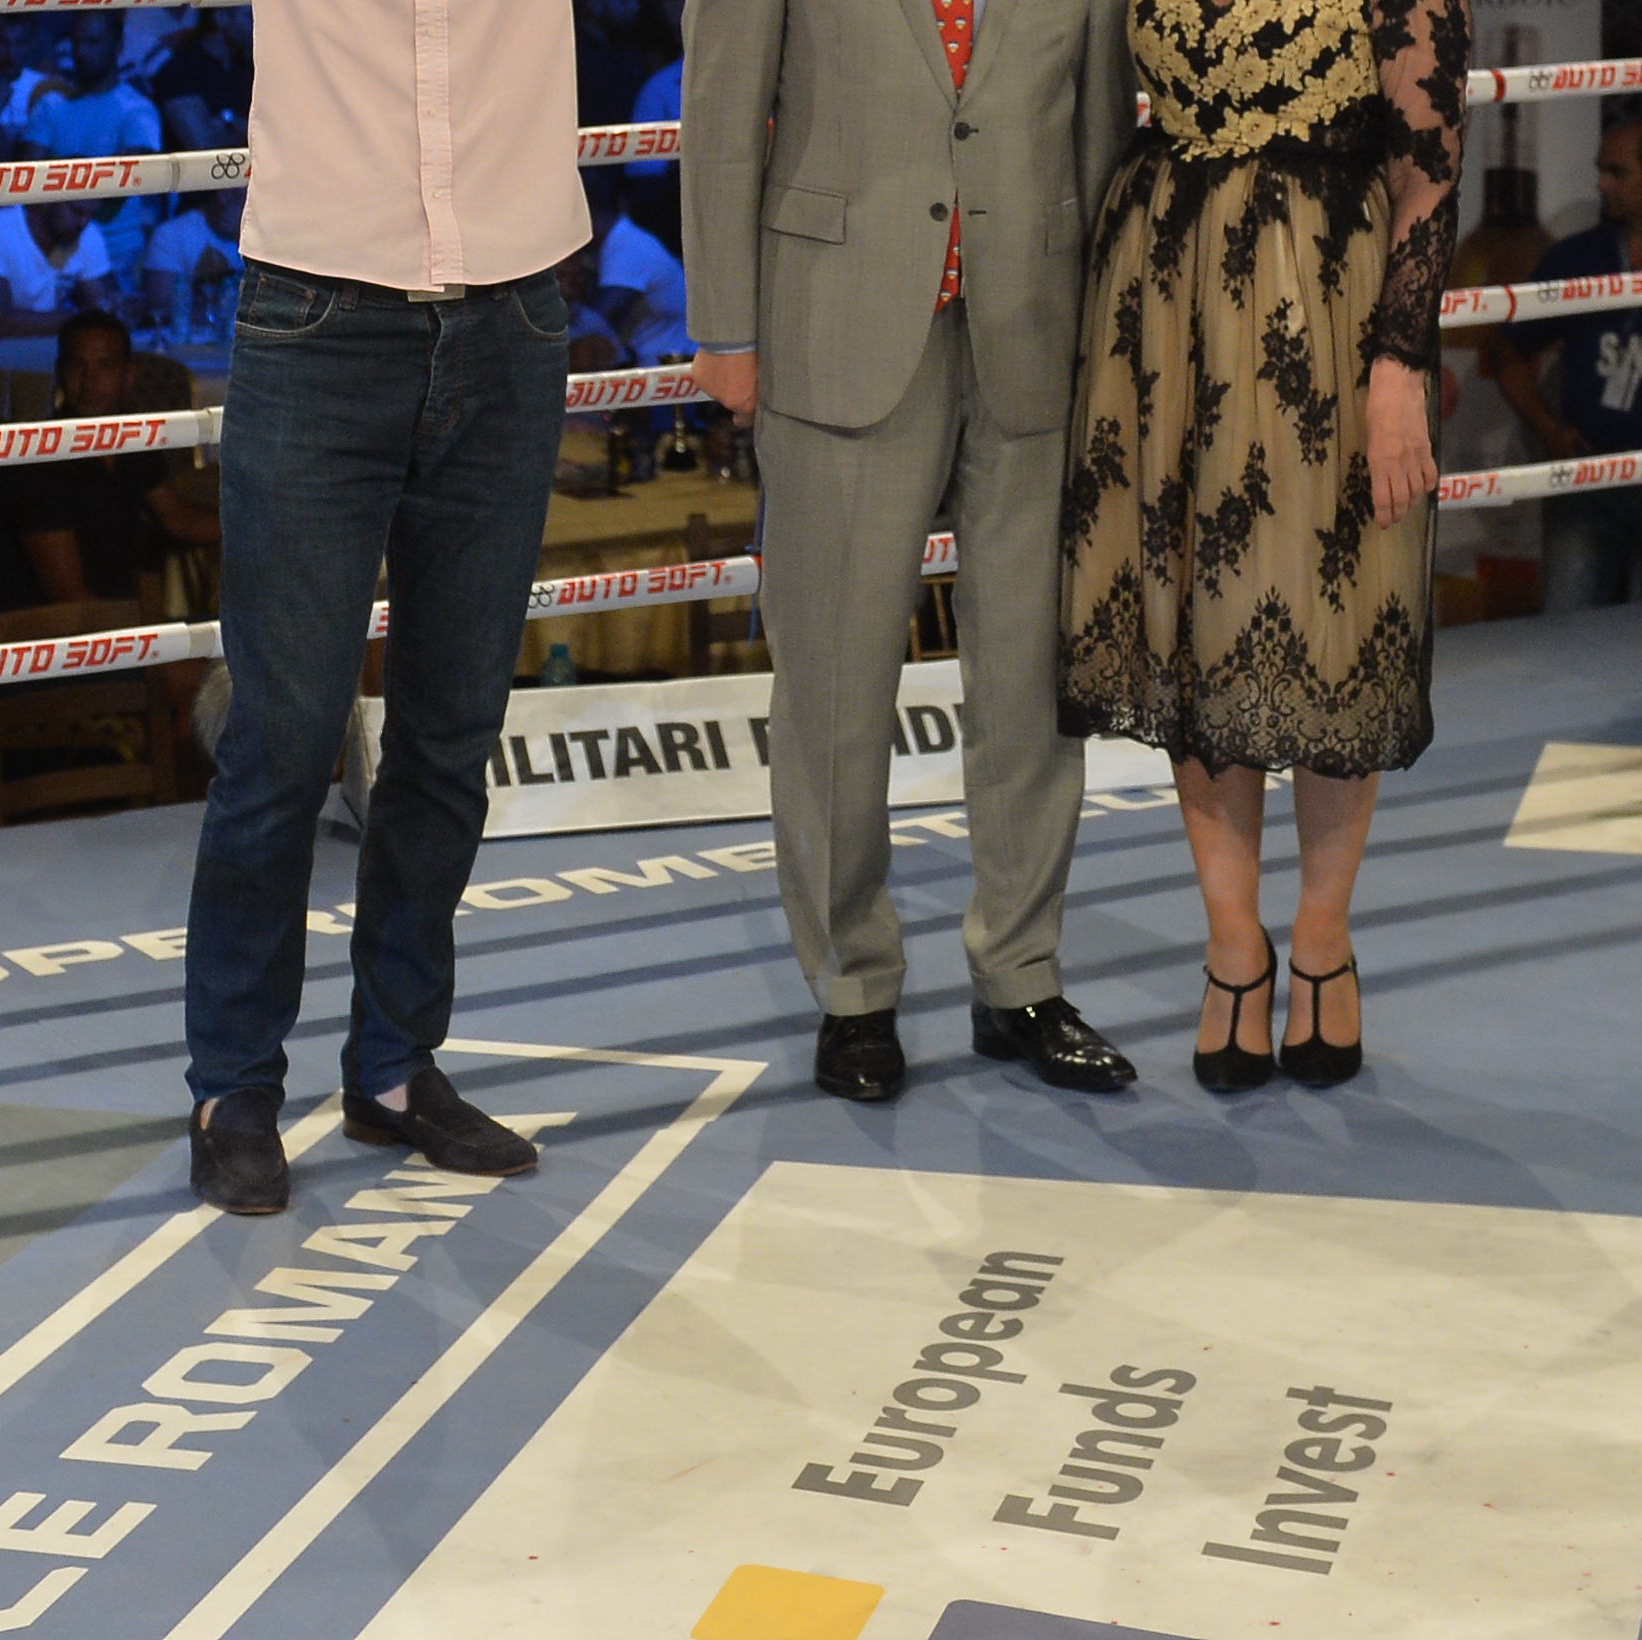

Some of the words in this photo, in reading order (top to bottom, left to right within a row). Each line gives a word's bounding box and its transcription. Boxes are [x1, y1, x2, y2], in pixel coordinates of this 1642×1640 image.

[1552, 64, 1617, 91] AUTO
[636, 127, 680, 155] SO
[43, 160, 141, 192] SOFT
[1562, 275, 1625, 300] AUTO
[566, 376, 648, 408] AUTO
[656, 369, 702, 400] SO
[71, 419, 166, 452] SOFT
[1573, 456, 1637, 485] AUTO
[558, 570, 639, 605] AUTO
[648, 560, 726, 593] SOFT
[64, 633, 159, 669] SOFT
[487, 718, 731, 791] ILITARI
[59, 1112, 577, 1471] ROMAN
[791, 1249, 1064, 1507] European
[992, 1364, 1197, 1541] Funds
[1201, 1383, 1393, 1576] Invest
